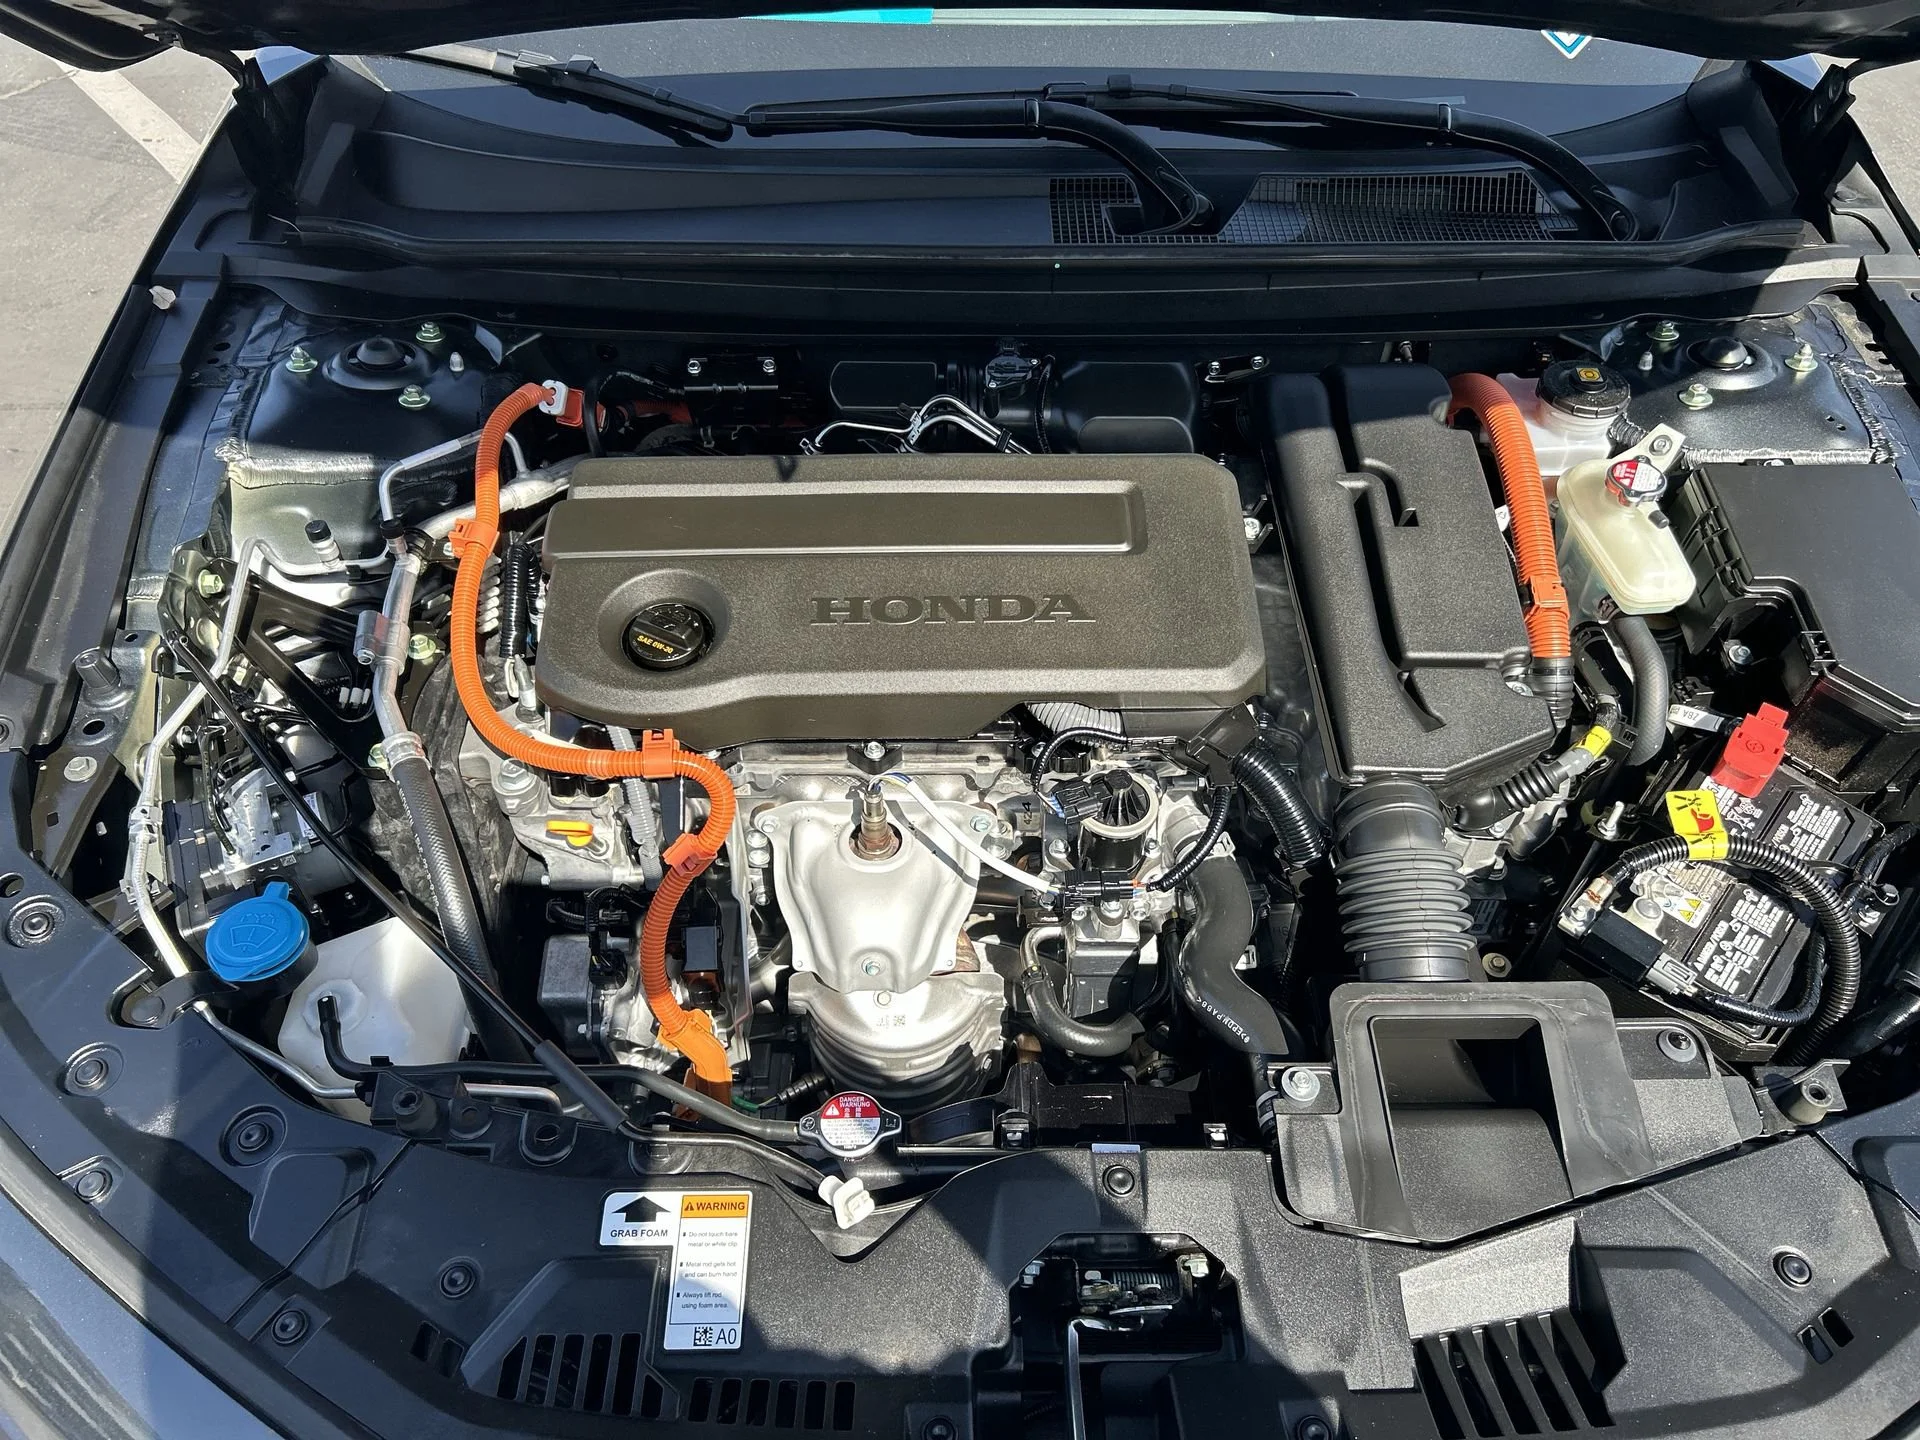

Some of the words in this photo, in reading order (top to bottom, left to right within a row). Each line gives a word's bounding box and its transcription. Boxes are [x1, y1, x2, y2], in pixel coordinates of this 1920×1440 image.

[810, 594, 1097, 625] HONDA
[636, 635, 653, 646] SAE
[652, 641, 674, 654] 0W-20
[1021, 801, 1033, 825] 424
[696, 1202, 746, 1211] WARNING
[610, 1229, 638, 1238] GRAB
[640, 1229, 668, 1238] FOAM
[713, 1261, 726, 1269] gets
[715, 1328, 737, 1345] A0
